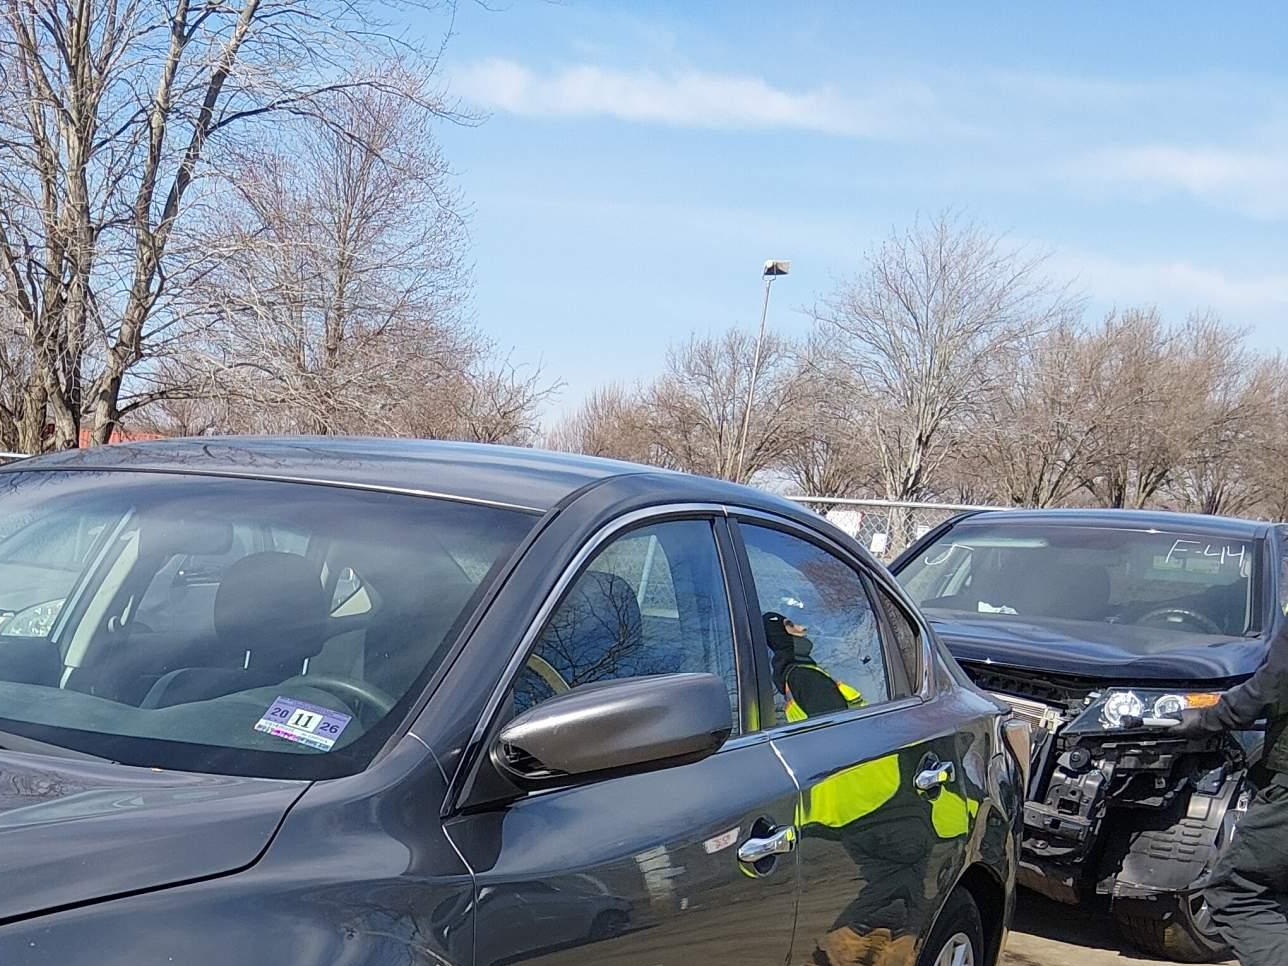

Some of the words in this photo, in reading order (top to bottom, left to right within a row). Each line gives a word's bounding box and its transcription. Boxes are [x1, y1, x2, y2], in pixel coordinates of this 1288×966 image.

[1165, 538, 1245, 568] F-44
[270, 707, 289, 719] 20
[293, 712, 314, 729] 11
[319, 722, 340, 734] 26
